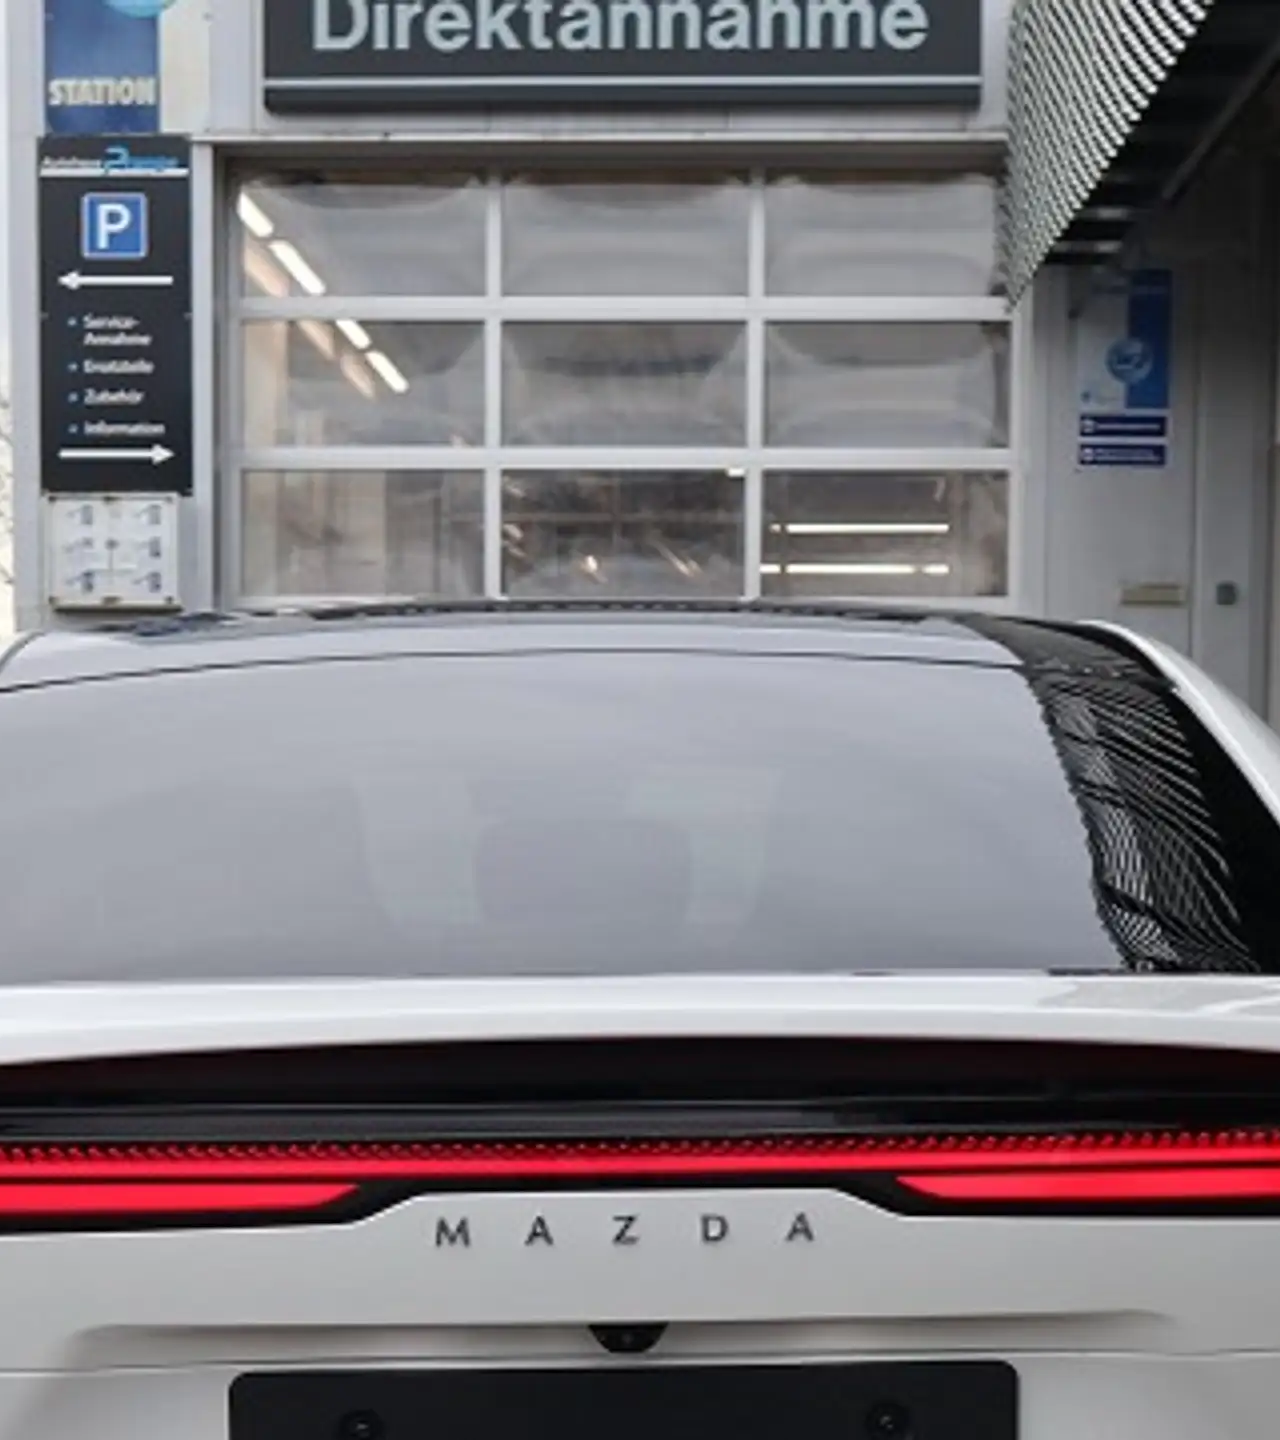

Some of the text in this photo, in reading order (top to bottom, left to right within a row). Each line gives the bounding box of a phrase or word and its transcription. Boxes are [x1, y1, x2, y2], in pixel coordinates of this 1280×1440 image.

[313, 0, 928, 53] Direktannahme
[48, 77, 157, 106] STATION
[96, 202, 132, 250] P
[434, 1212, 816, 1249] MAZDA
